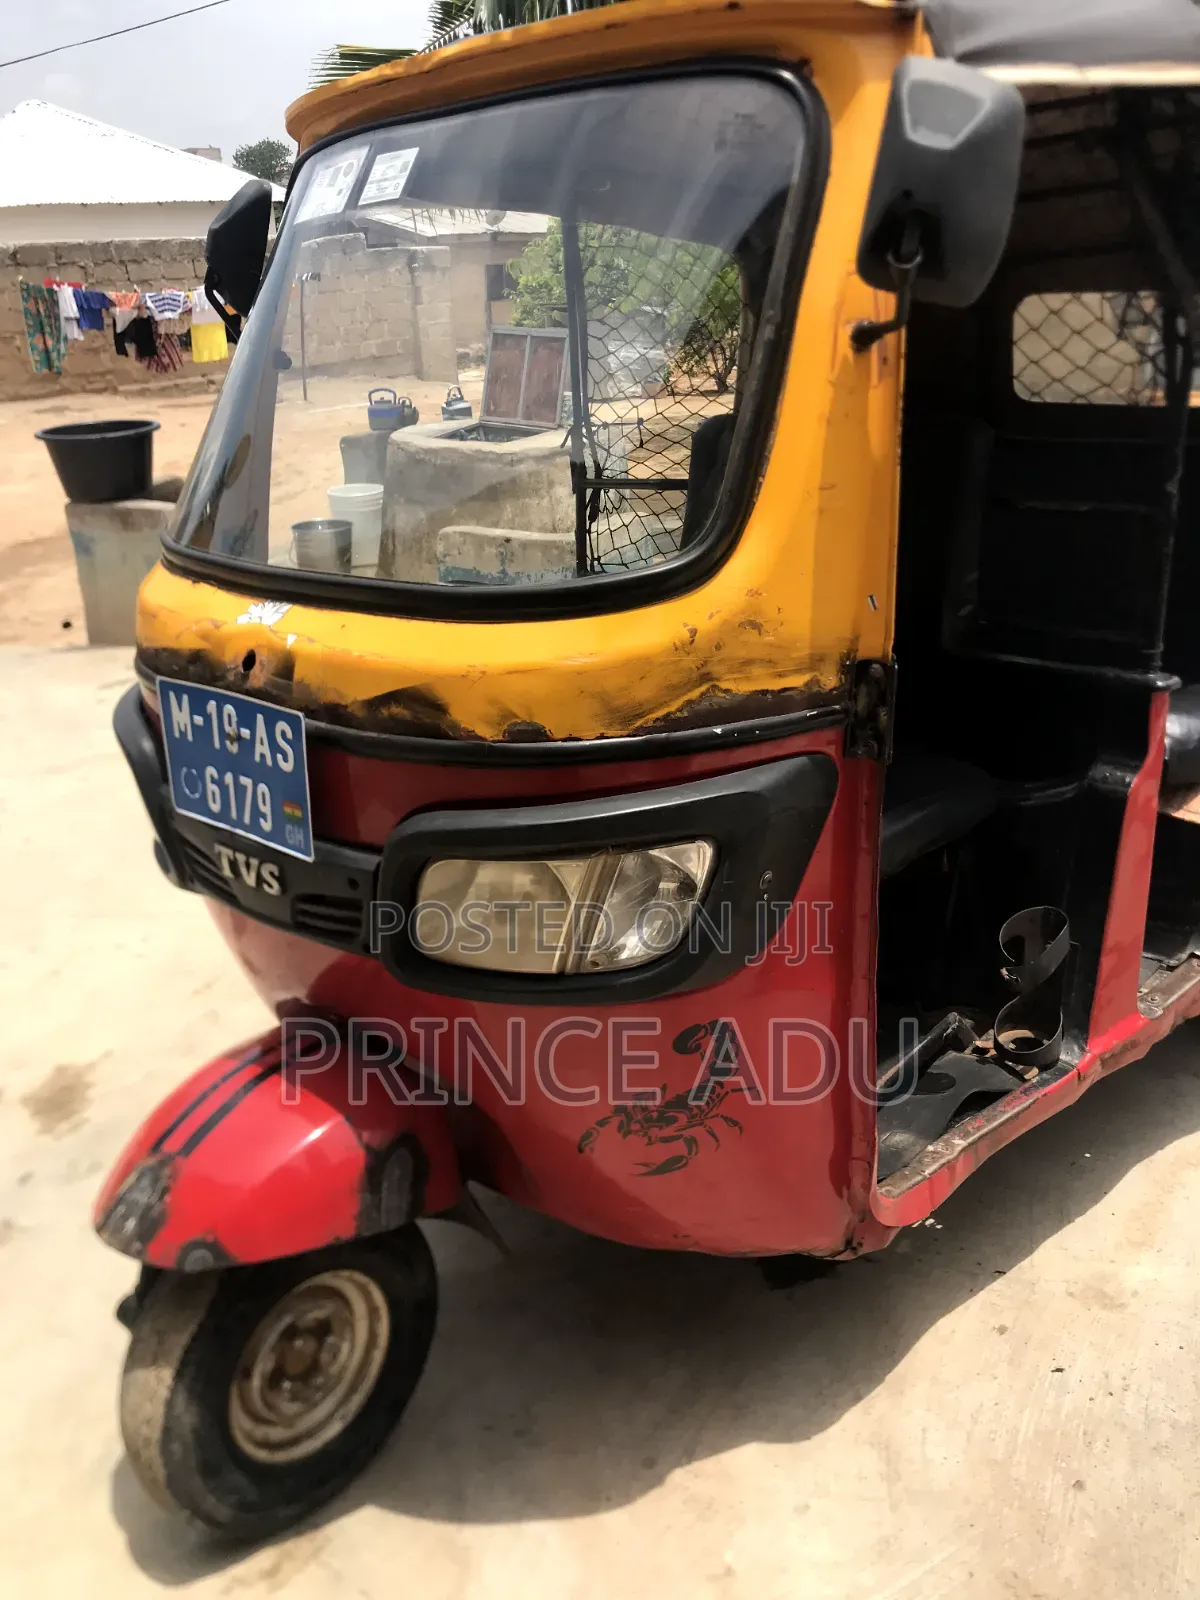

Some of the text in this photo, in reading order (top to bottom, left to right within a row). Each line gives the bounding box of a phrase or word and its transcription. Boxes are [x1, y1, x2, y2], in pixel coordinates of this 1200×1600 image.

[168, 691, 294, 773] M-19-AS
[204, 765, 272, 832] 6179
[214, 843, 282, 896] TVS
